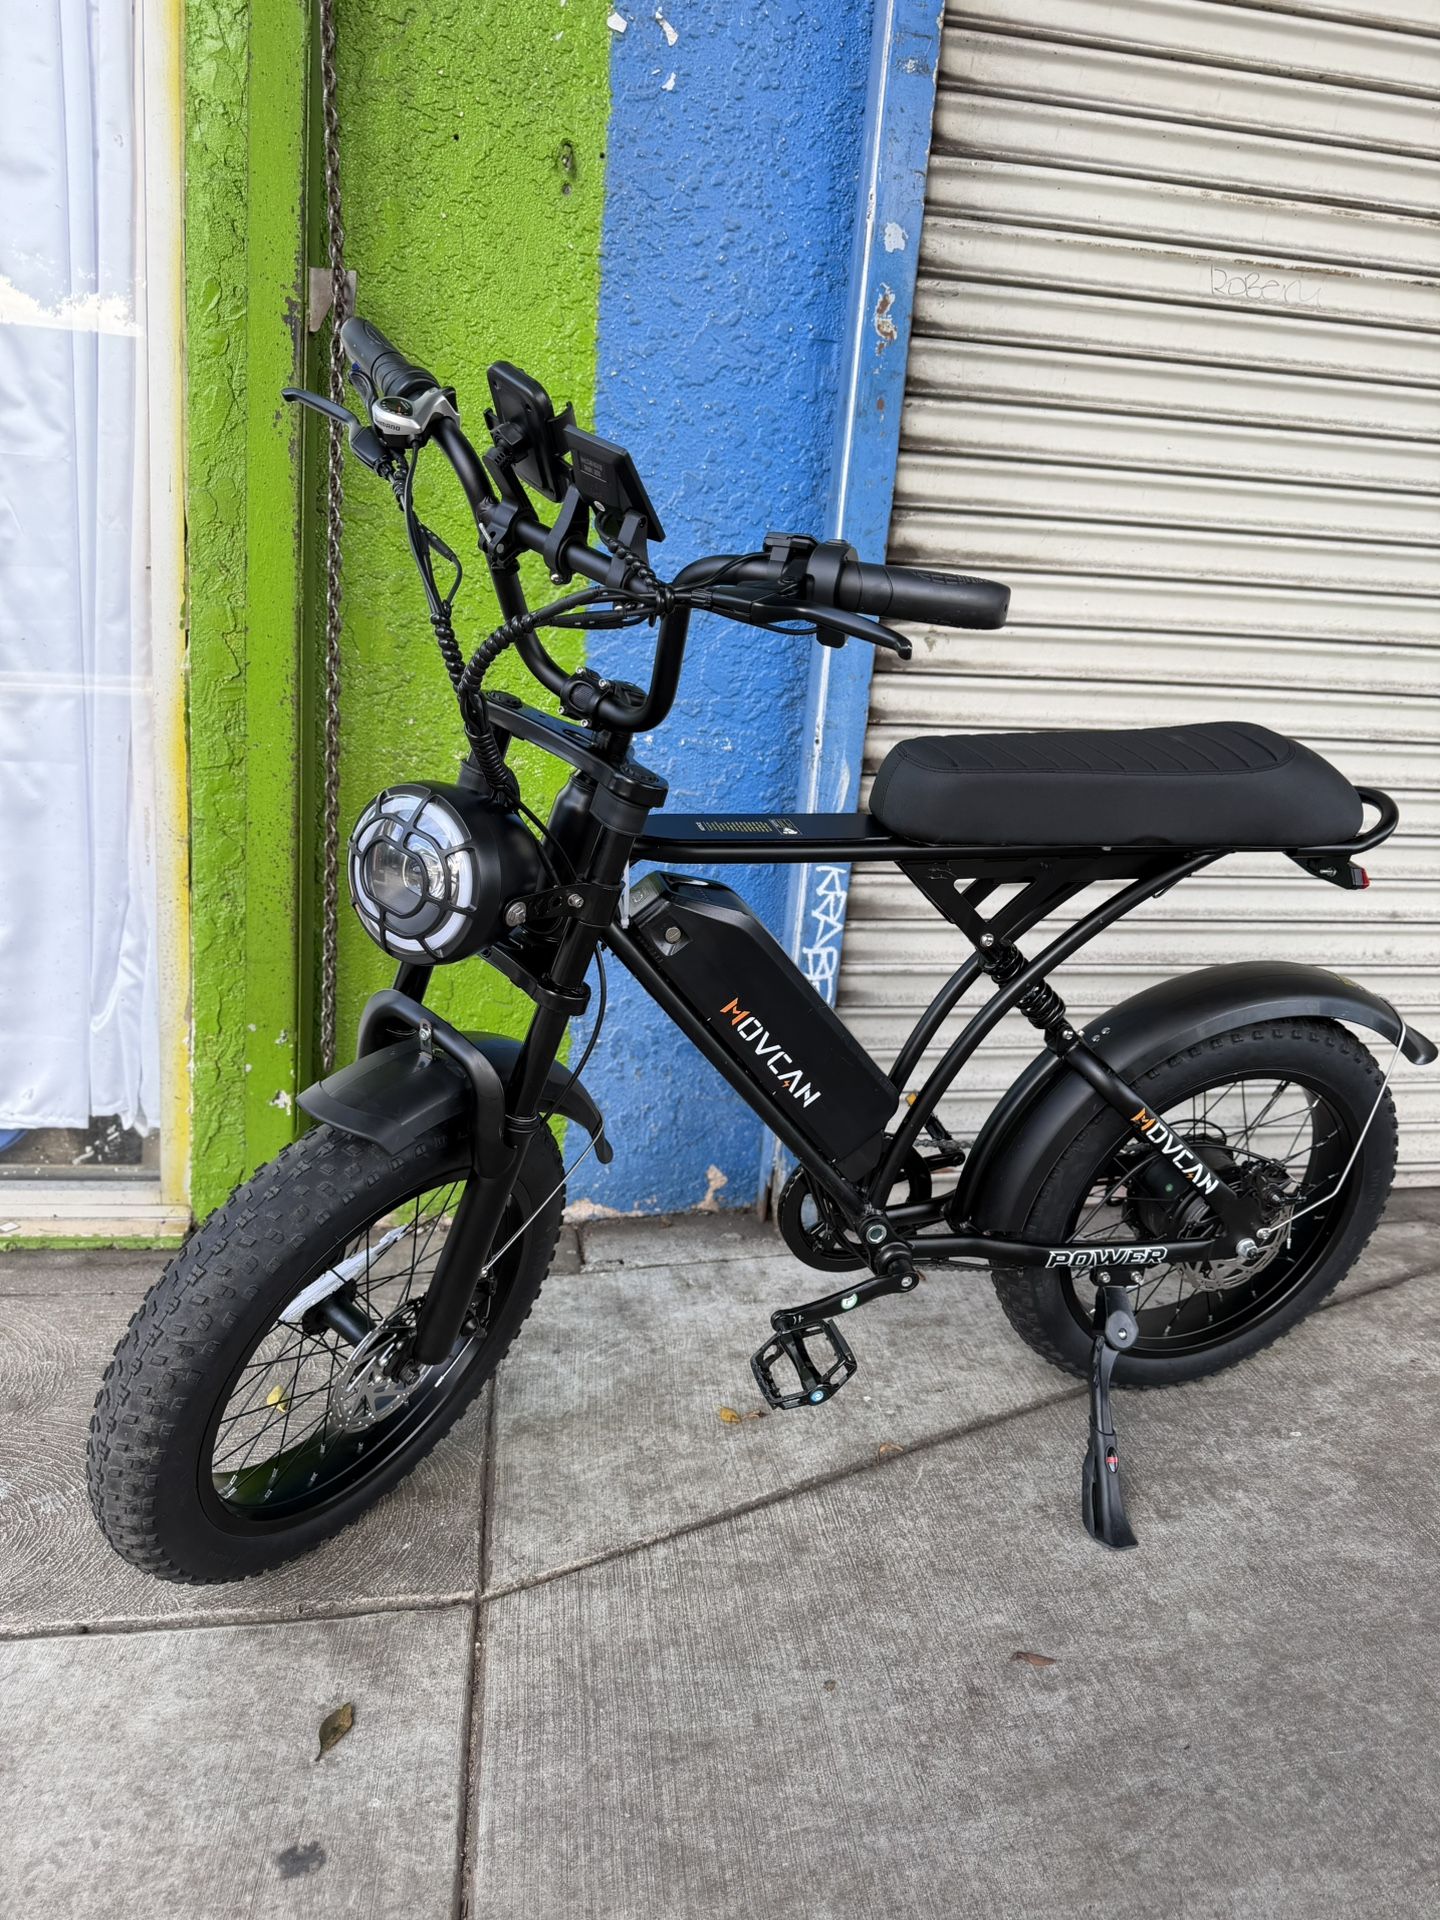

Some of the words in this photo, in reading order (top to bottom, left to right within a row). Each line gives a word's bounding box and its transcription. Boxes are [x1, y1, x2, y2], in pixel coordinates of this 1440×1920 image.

[720, 997, 821, 1108] MOVCAN
[1130, 1107, 1220, 1195] MOVCAN
[1045, 1246, 1168, 1268] POWER
